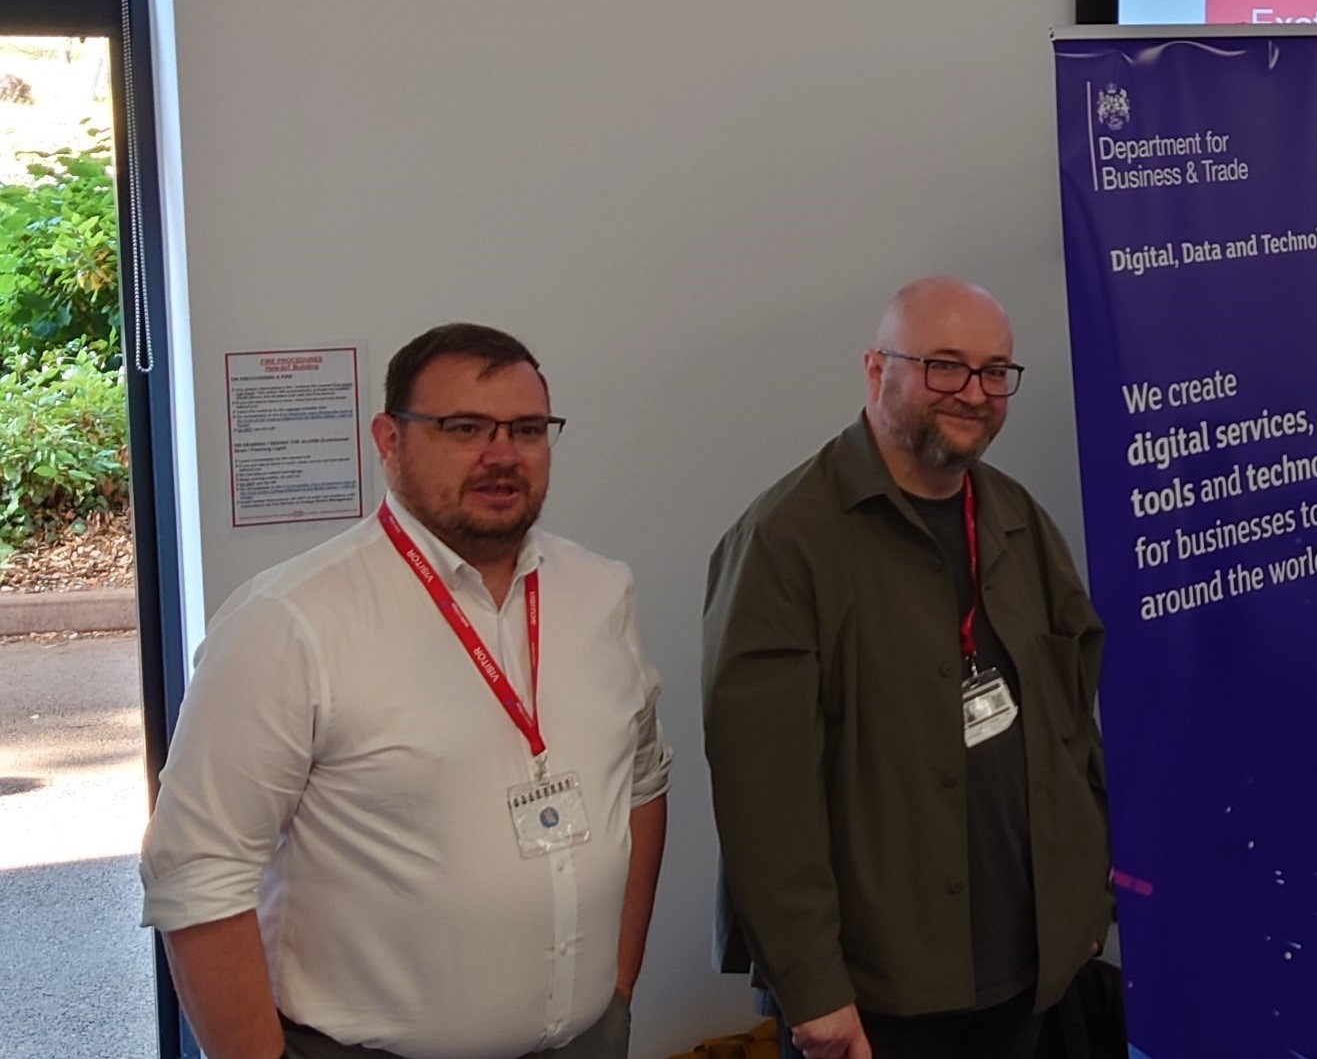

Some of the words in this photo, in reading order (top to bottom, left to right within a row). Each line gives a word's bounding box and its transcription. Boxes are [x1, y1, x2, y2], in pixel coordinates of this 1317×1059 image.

[1099, 132, 1202, 164] Department
[1205, 130, 1229, 153] for
[1102, 164, 1182, 190] Business
[1186, 161, 1199, 184] &
[1200, 158, 1249, 182] Trade
[1110, 243, 1179, 275] Digital,
[1181, 241, 1223, 264] Data
[1226, 234, 1258, 259] and
[1122, 382, 1162, 414] We
[1168, 370, 1237, 407] create
[1127, 421, 1210, 470] digital
[1216, 409, 1314, 448] services,
[1130, 477, 1195, 517] tools
[1201, 464, 1243, 502] and
[1135, 536, 1171, 569] for
[1175, 510, 1296, 559] businesses
[406, 549, 434, 583] VISITOR
[1141, 570, 1224, 620] around
[1227, 564, 1264, 596] the
[473, 646, 499, 683] VISITOR
